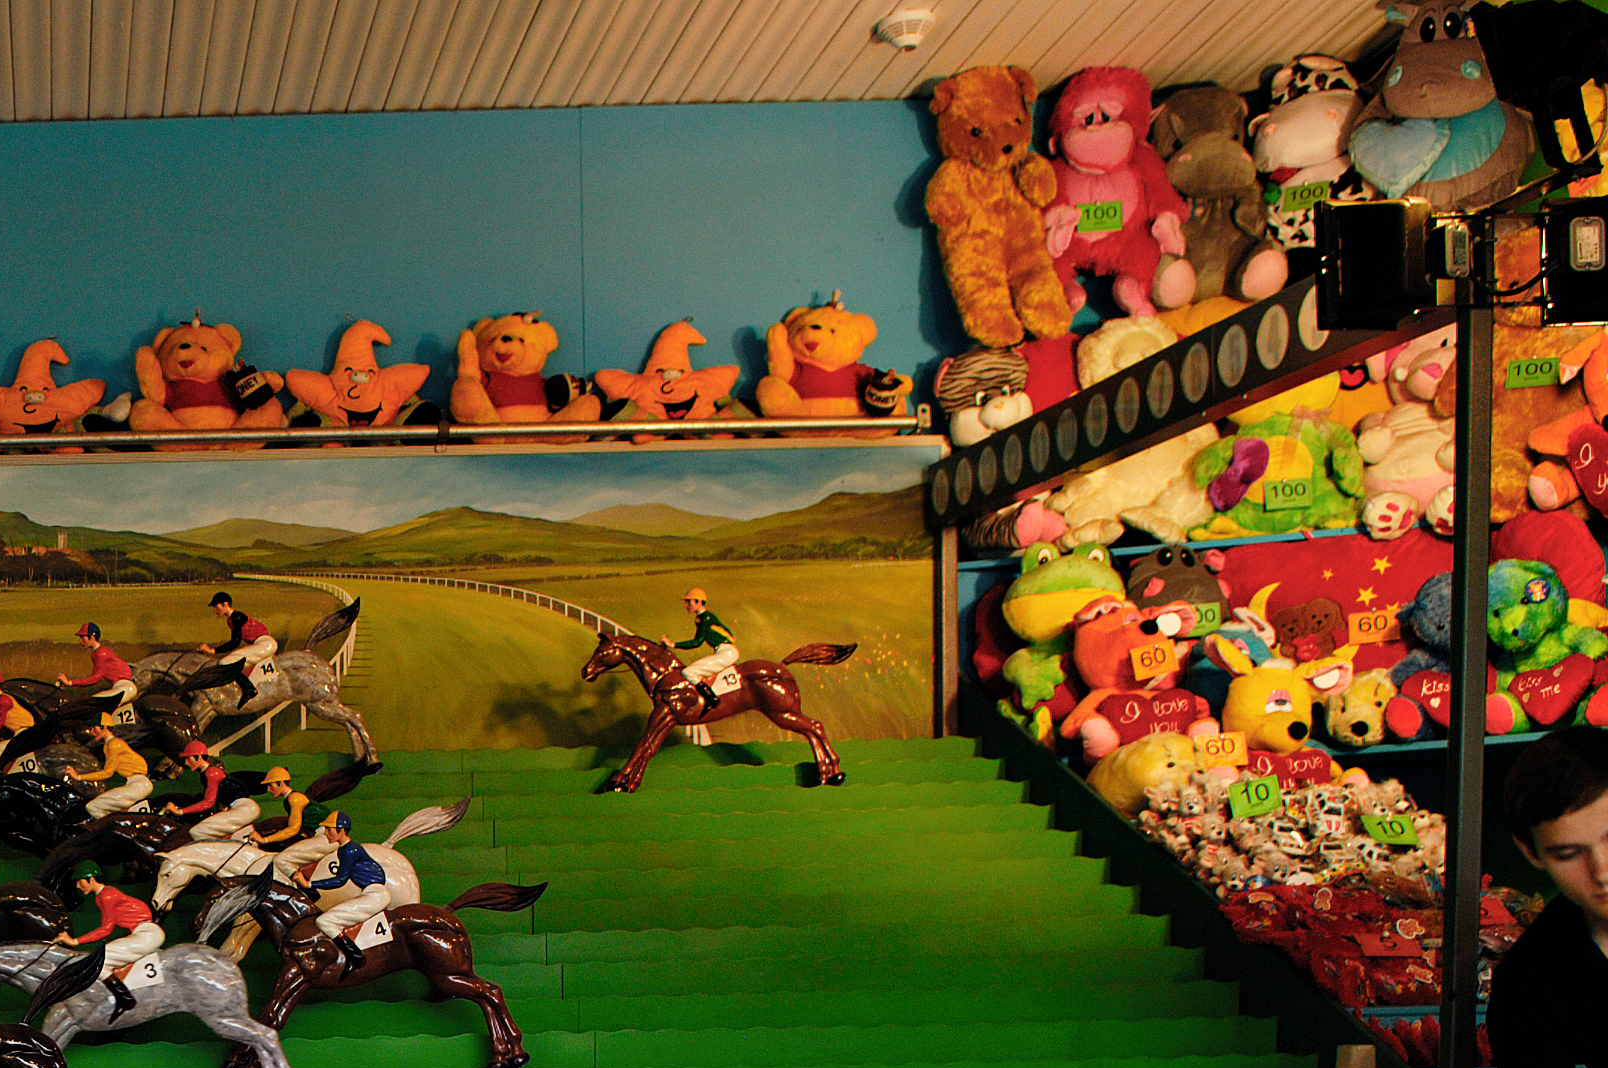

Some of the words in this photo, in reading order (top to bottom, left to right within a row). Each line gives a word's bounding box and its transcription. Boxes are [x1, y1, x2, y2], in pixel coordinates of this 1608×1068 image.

[1290, 185, 1325, 202] 100
[1082, 205, 1118, 221] 100
[1513, 361, 1553, 377] 100
[1271, 482, 1306, 498] 100
[1196, 608, 1216, 624] 00
[1358, 614, 1388, 633] 60
[1139, 647, 1166, 667] 60
[261, 662, 275, 676] 14
[722, 673, 738, 686] 13
[1517, 676, 1543, 692] kiss
[1420, 678, 1450, 698] kiss
[1540, 683, 1561, 699] me
[117, 710, 134, 724] 12
[1205, 736, 1235, 756] 60
[18, 758, 36, 773] 10
[1241, 782, 1270, 805] 10
[1376, 819, 1405, 836] 10
[328, 860, 340, 876] 6
[375, 922, 387, 936] 4
[144, 963, 157, 978] 3
